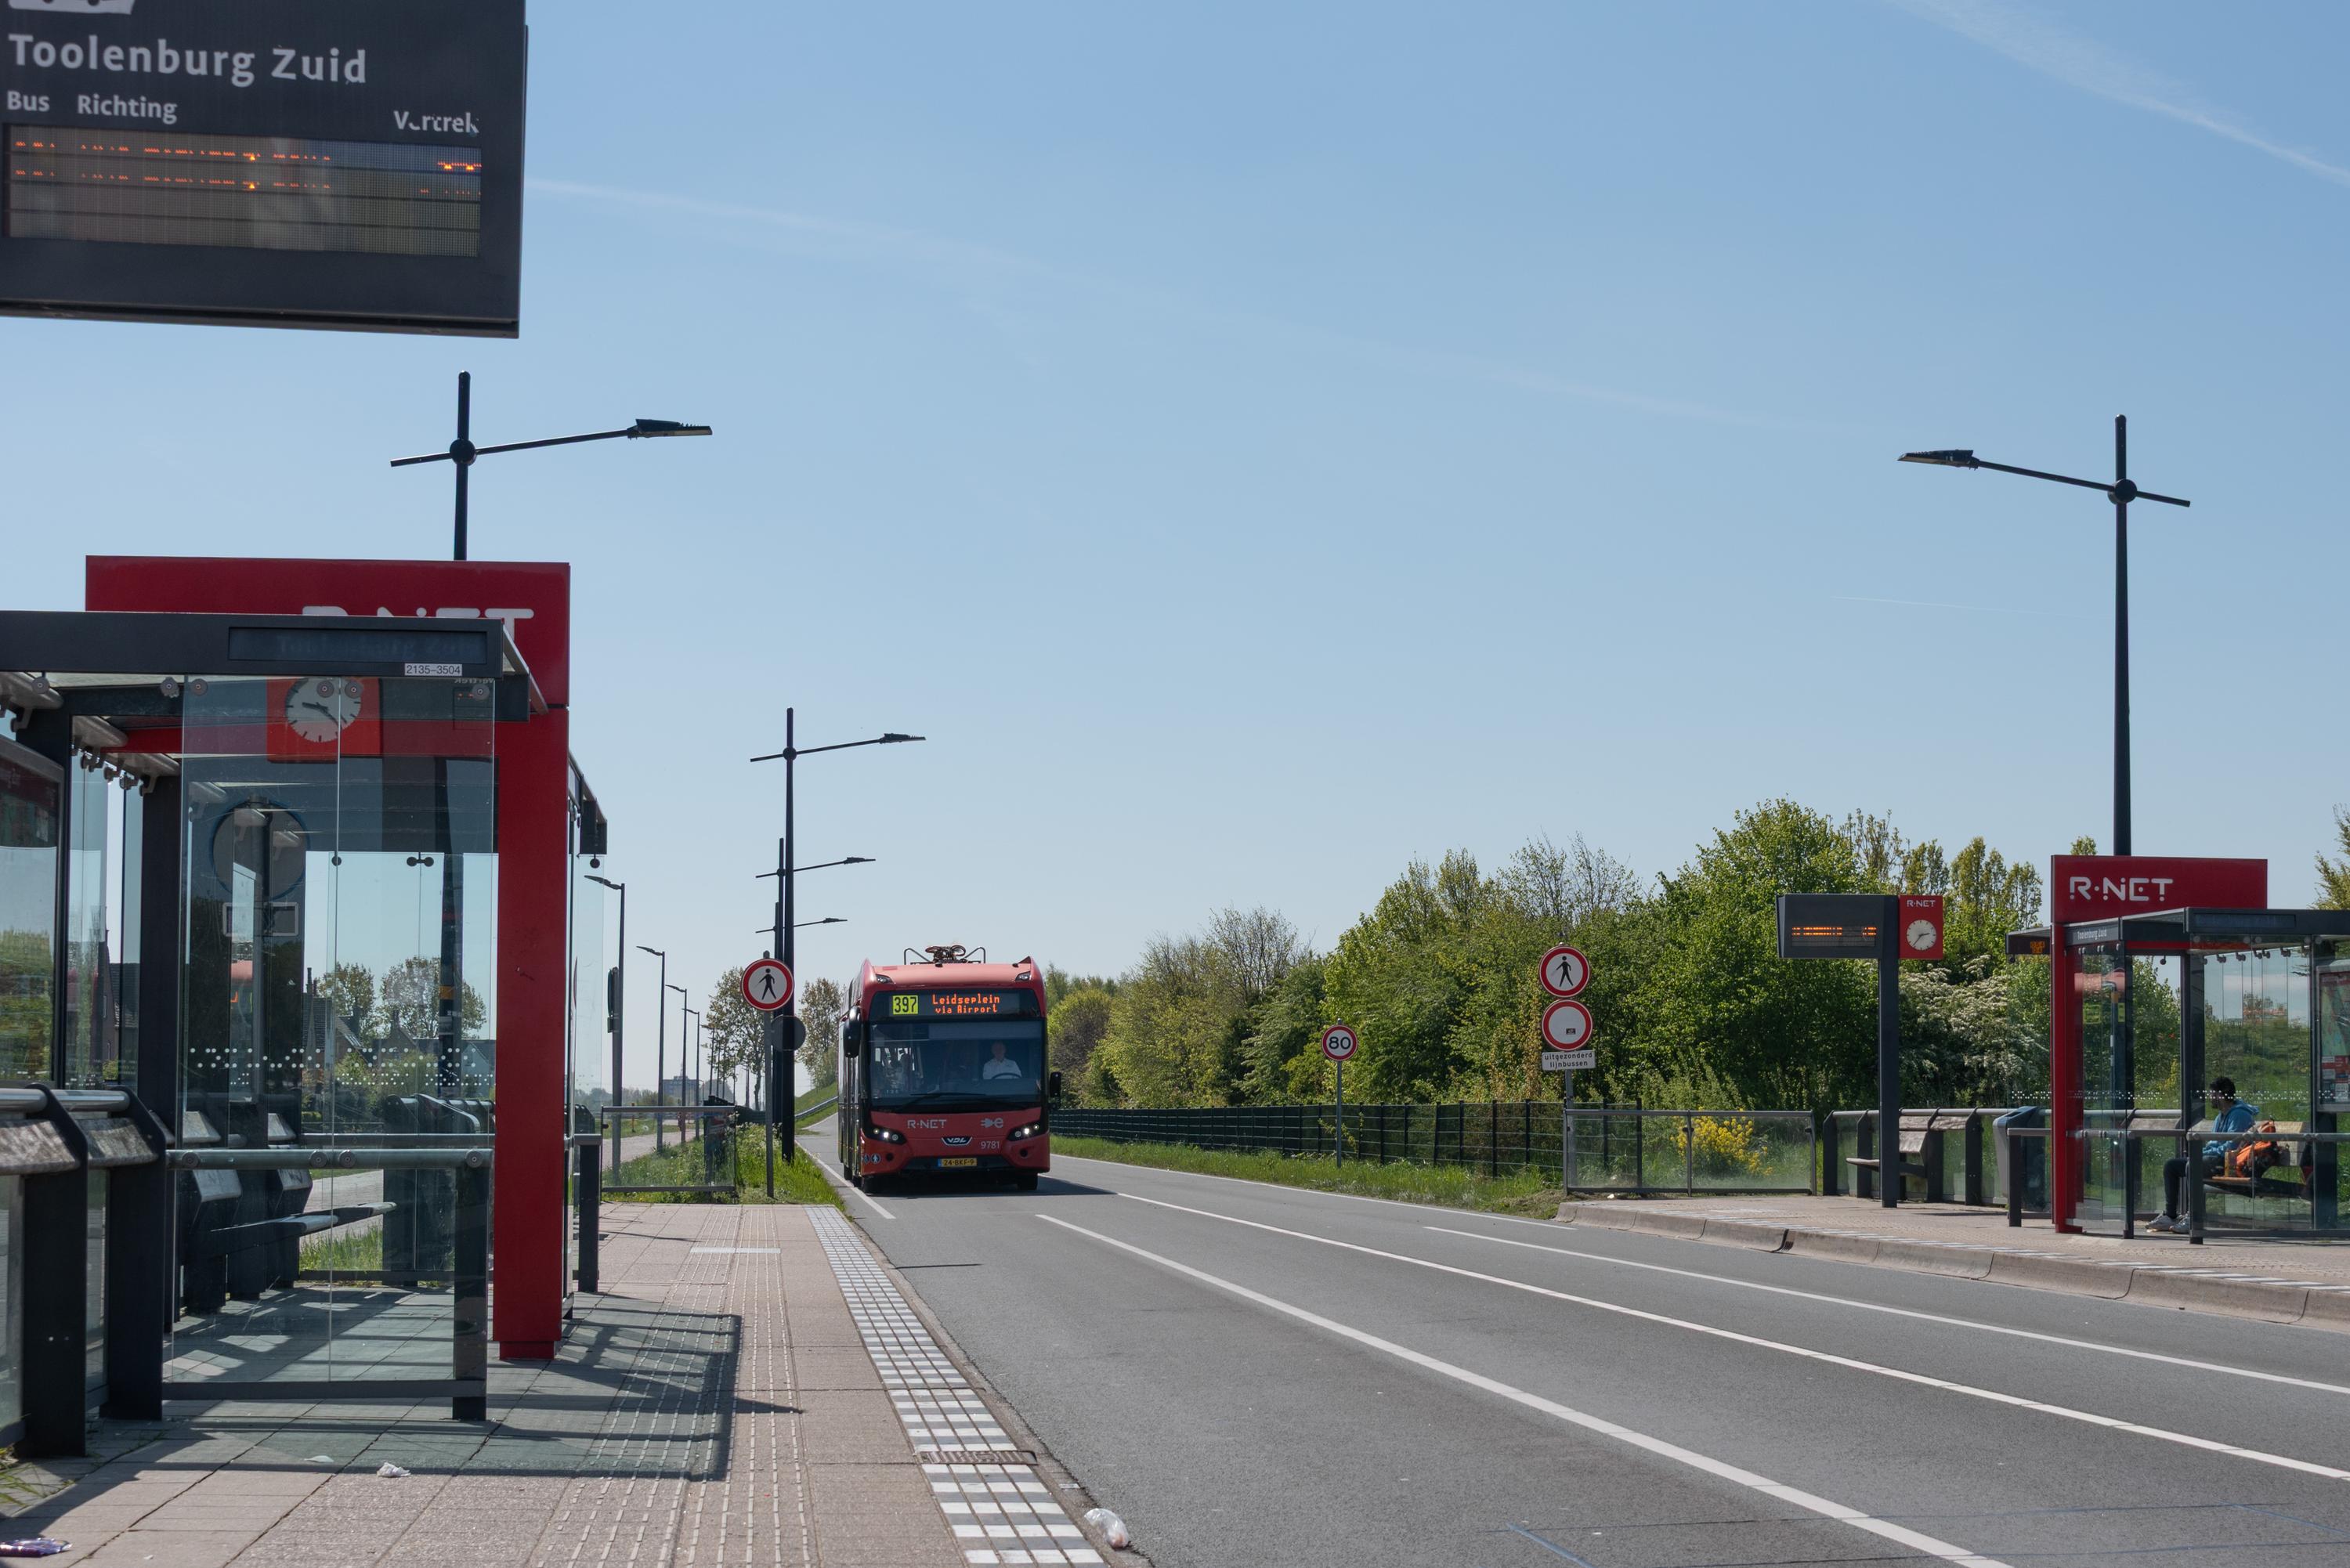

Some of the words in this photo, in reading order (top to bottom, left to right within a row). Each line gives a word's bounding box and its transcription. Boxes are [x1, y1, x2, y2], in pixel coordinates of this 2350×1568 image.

[8, 33, 255, 87] Toolenburg
[271, 47, 367, 84] Zuid
[6, 90, 50, 113] Bus
[77, 92, 178, 125] Richting
[406, 664, 461, 674] 2135-3504
[894, 996, 917, 1013] 397
[932, 993, 1000, 1005] Leidseplein
[957, 1004, 998, 1014] Airport
[1329, 1036, 1351, 1050] 80
[1544, 1052, 1593, 1061] uitgezonderd
[981, 1140, 1000, 1149] 9781
